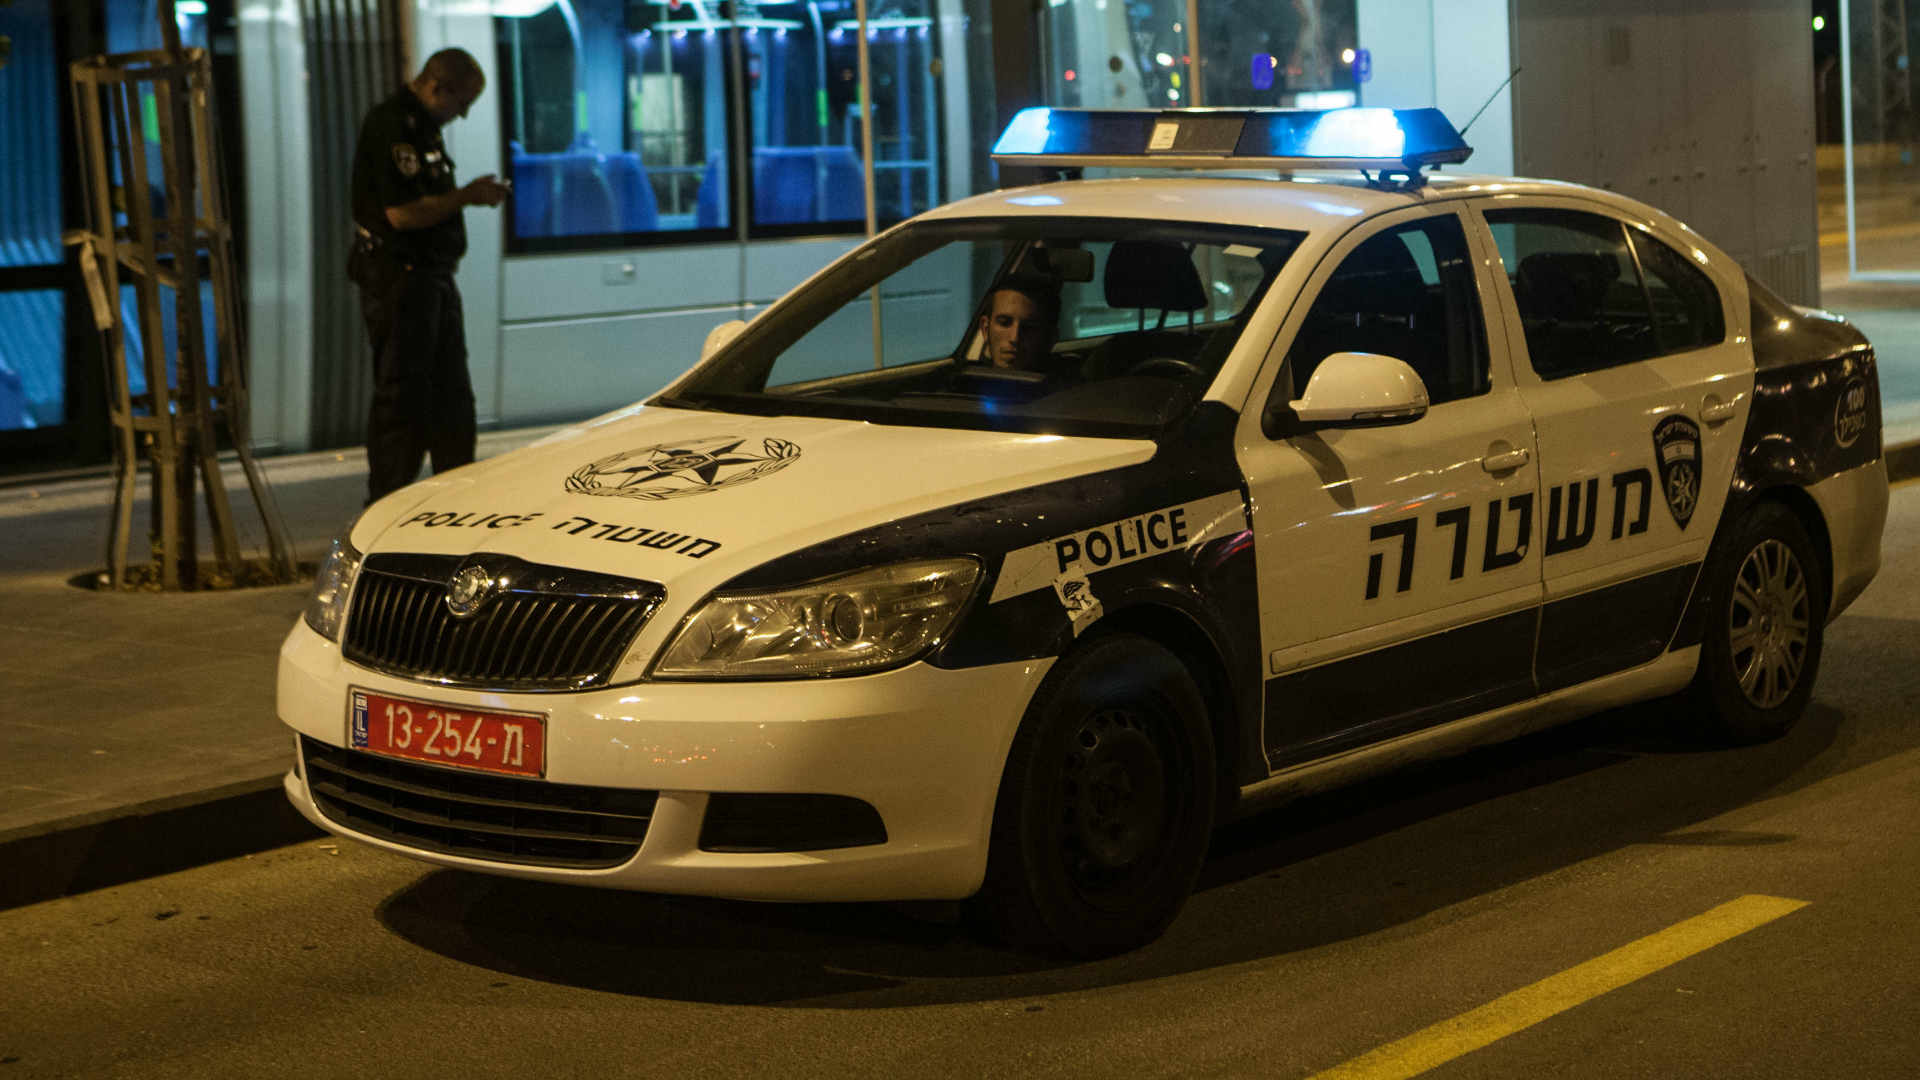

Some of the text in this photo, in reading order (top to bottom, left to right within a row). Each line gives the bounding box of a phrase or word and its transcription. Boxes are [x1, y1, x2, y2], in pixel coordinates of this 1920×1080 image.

[552, 517, 722, 558] משטרה
[1056, 508, 1188, 573] POLICE
[1365, 468, 1652, 600] משטרה
